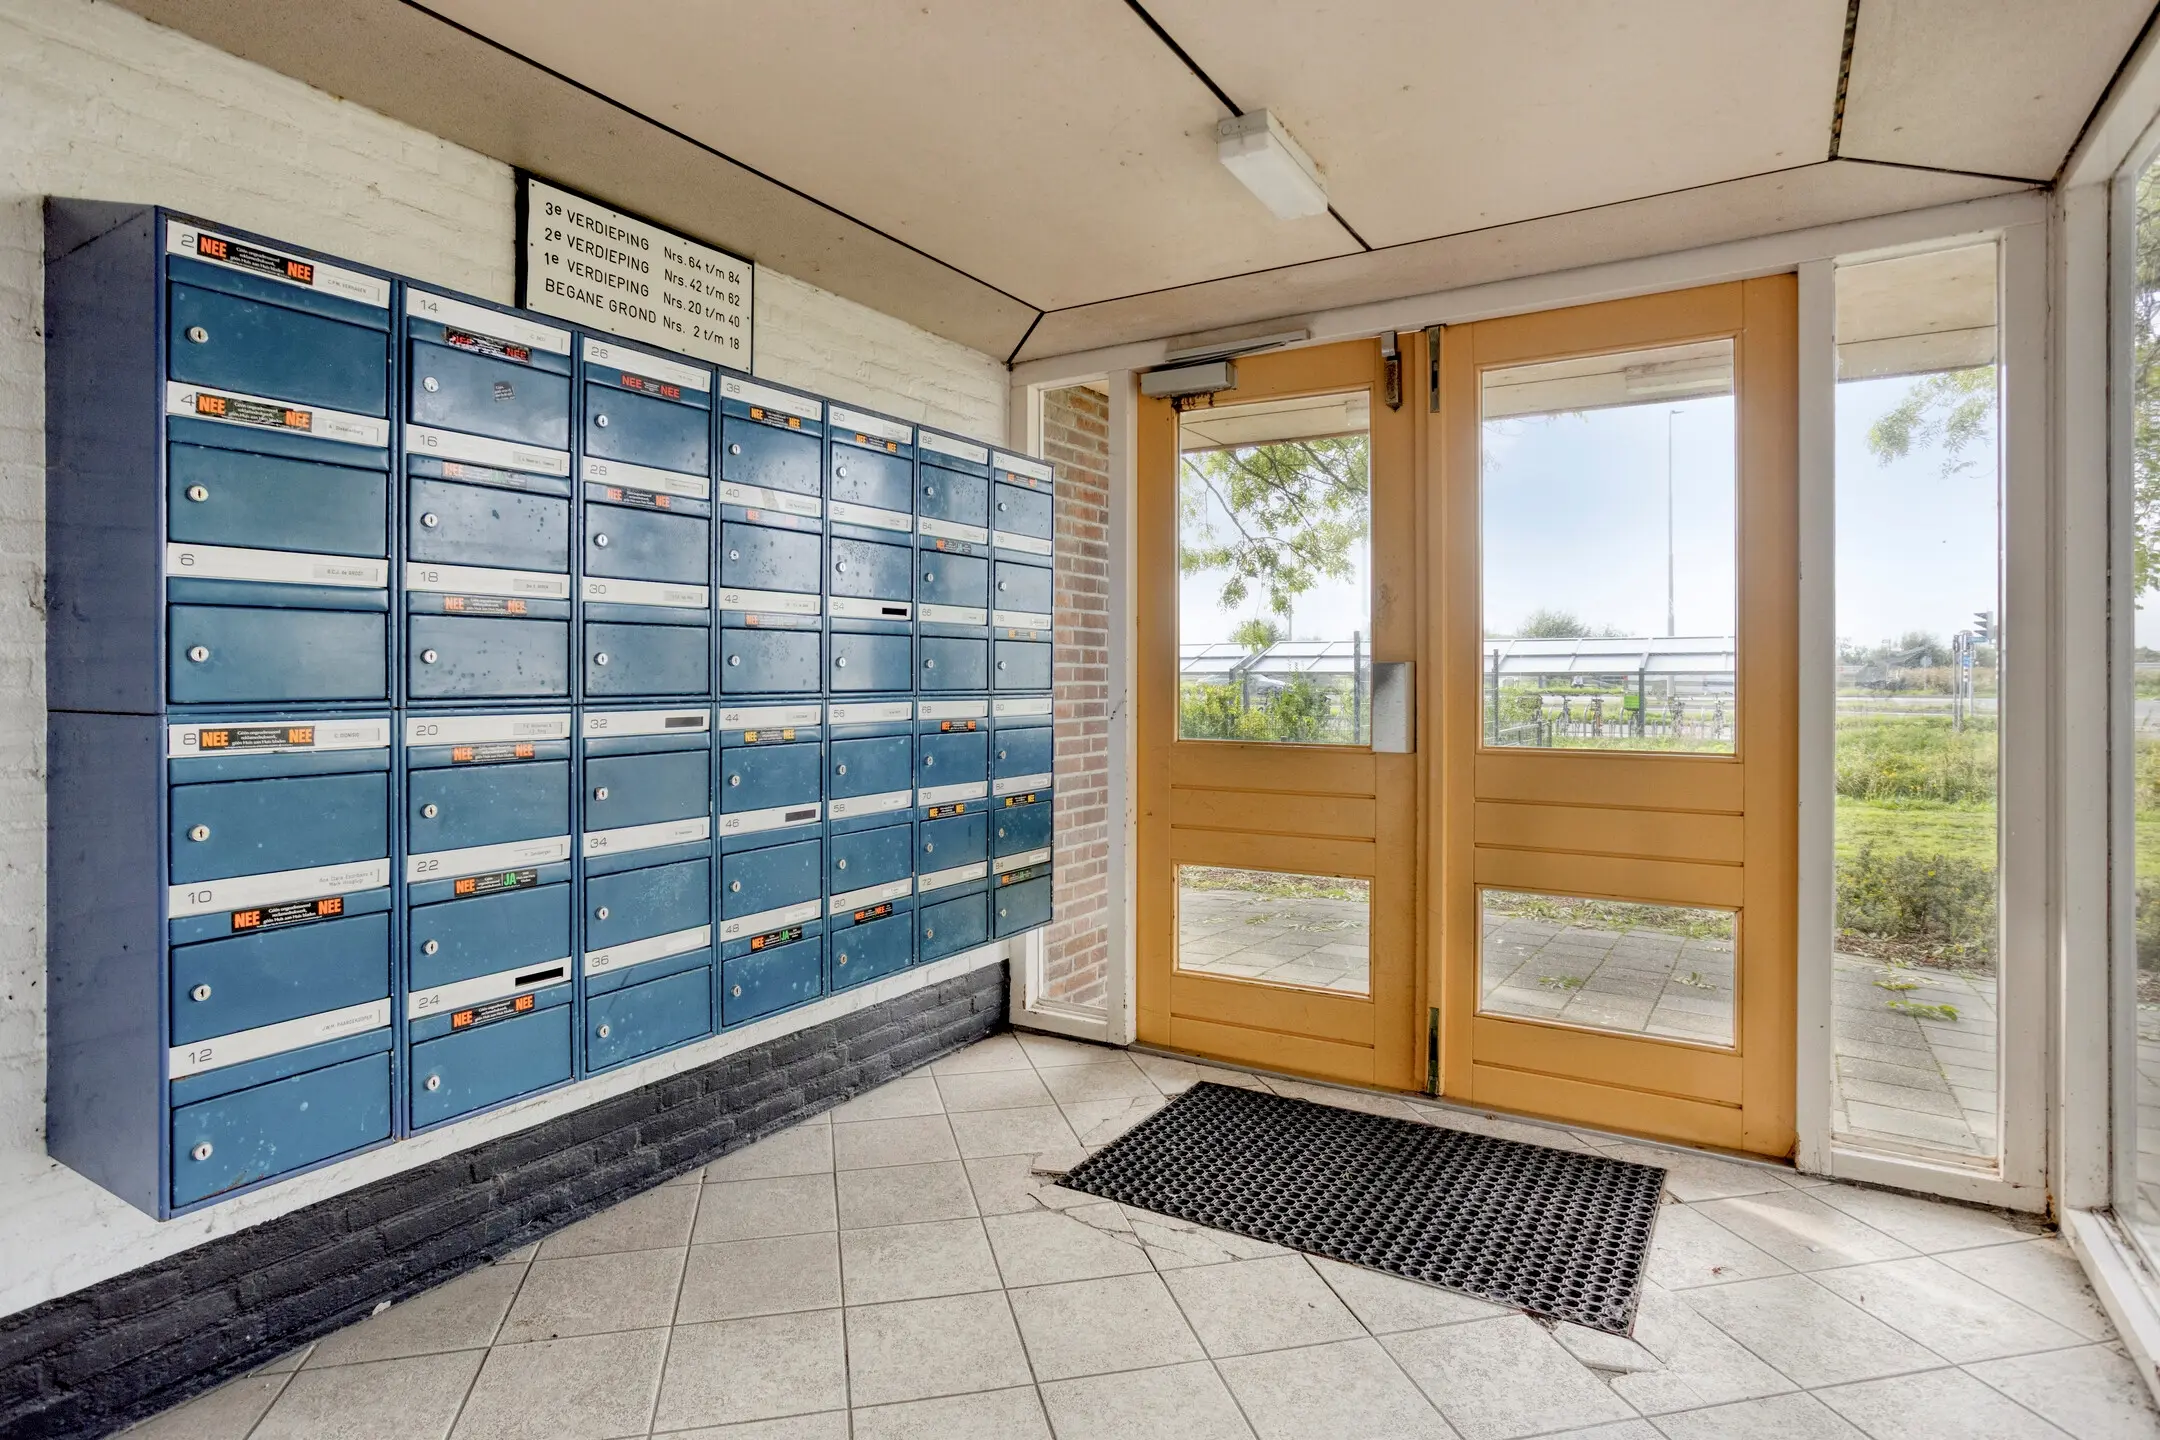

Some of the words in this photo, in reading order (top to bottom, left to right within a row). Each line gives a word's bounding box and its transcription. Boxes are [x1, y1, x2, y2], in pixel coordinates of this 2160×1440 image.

[181, 234, 195, 249] 2
[200, 237, 227, 259] NEE
[545, 202, 562, 216] 3e
[567, 209, 650, 251] VERDIEPING
[688, 257, 702, 271] 64
[705, 262, 725, 280] t/m
[728, 271, 740, 285] 84
[287, 261, 312, 283] NEE
[544, 227, 562, 241] 2e
[566, 233, 650, 274] VERDIEPING
[689, 277, 702, 293] 42
[706, 284, 725, 301] t/m
[728, 293, 740, 307] 62
[544, 252, 560, 266] 1e
[567, 258, 650, 297] VERDIEPING
[688, 300, 702, 315] 20
[705, 306, 725, 323] t/m
[728, 315, 740, 328] 40
[420, 299, 439, 314] 14
[545, 278, 604, 309] BEGANE
[608, 300, 657, 324] GROND
[663, 316, 686, 334] Nrs.
[693, 325, 701, 338] 2
[703, 329, 724, 345] t/m
[730, 336, 740, 349] 18
[506, 347, 528, 361] NEE
[590, 346, 609, 360] 26
[621, 375, 642, 389] NEE
[726, 383, 740, 394] 38
[660, 386, 680, 399] NEE
[180, 394, 195, 407] 4
[199, 396, 226, 415] NEE
[285, 409, 310, 428] NEE
[750, 406, 764, 420] NEE
[833, 412, 845, 423] 50
[788, 417, 801, 429] NEE
[419, 434, 438, 448] 16
[855, 433, 868, 444] NEE
[886, 442, 897, 453] NEE
[590, 464, 607, 476] 28
[607, 488, 623, 501] NEE
[725, 488, 740, 499] 40
[655, 495, 671, 509] NEE
[833, 505, 845, 516] 52
[180, 553, 195, 567] 6
[420, 571, 439, 583] 18
[588, 583, 607, 595] 30
[444, 596, 464, 611] NEE
[724, 594, 739, 604] 42
[507, 600, 527, 614] NEE
[832, 601, 845, 611] 54
[745, 614, 759, 626] NEE
[590, 718, 608, 729] 32
[725, 712, 739, 722] 44
[416, 724, 439, 736] 20
[941, 721, 951, 731] NEE
[967, 720, 976, 729] NEE
[183, 733, 197, 746] 8
[202, 731, 229, 747] NEE
[288, 728, 313, 744] NEE
[744, 730, 758, 743] NEE
[783, 728, 795, 740] NEE
[453, 747, 473, 761] NEE
[515, 744, 534, 757] NEE
[921, 791, 932, 800] 70
[1005, 797, 1014, 806] NEE
[1027, 793, 1036, 803] NEE
[929, 807, 939, 818] NEE
[955, 804, 965, 814] NEE
[725, 818, 740, 828] 46
[590, 837, 608, 849] 34
[417, 859, 439, 873] 22
[503, 872, 516, 886] JA
[922, 877, 932, 887] 72
[455, 879, 476, 895] NEE
[187, 890, 212, 905] 10
[318, 898, 342, 915] NEE
[874, 905, 885, 916] NEE
[234, 911, 260, 929] NEE
[854, 910, 865, 921] NEE
[725, 924, 740, 934] 48
[780, 930, 790, 942] JA
[751, 936, 764, 951] NEE
[591, 955, 609, 967] 36
[418, 995, 440, 1009] 24
[515, 996, 534, 1011] NEE
[453, 1011, 473, 1028] NEE
[188, 1048, 212, 1065] 12
